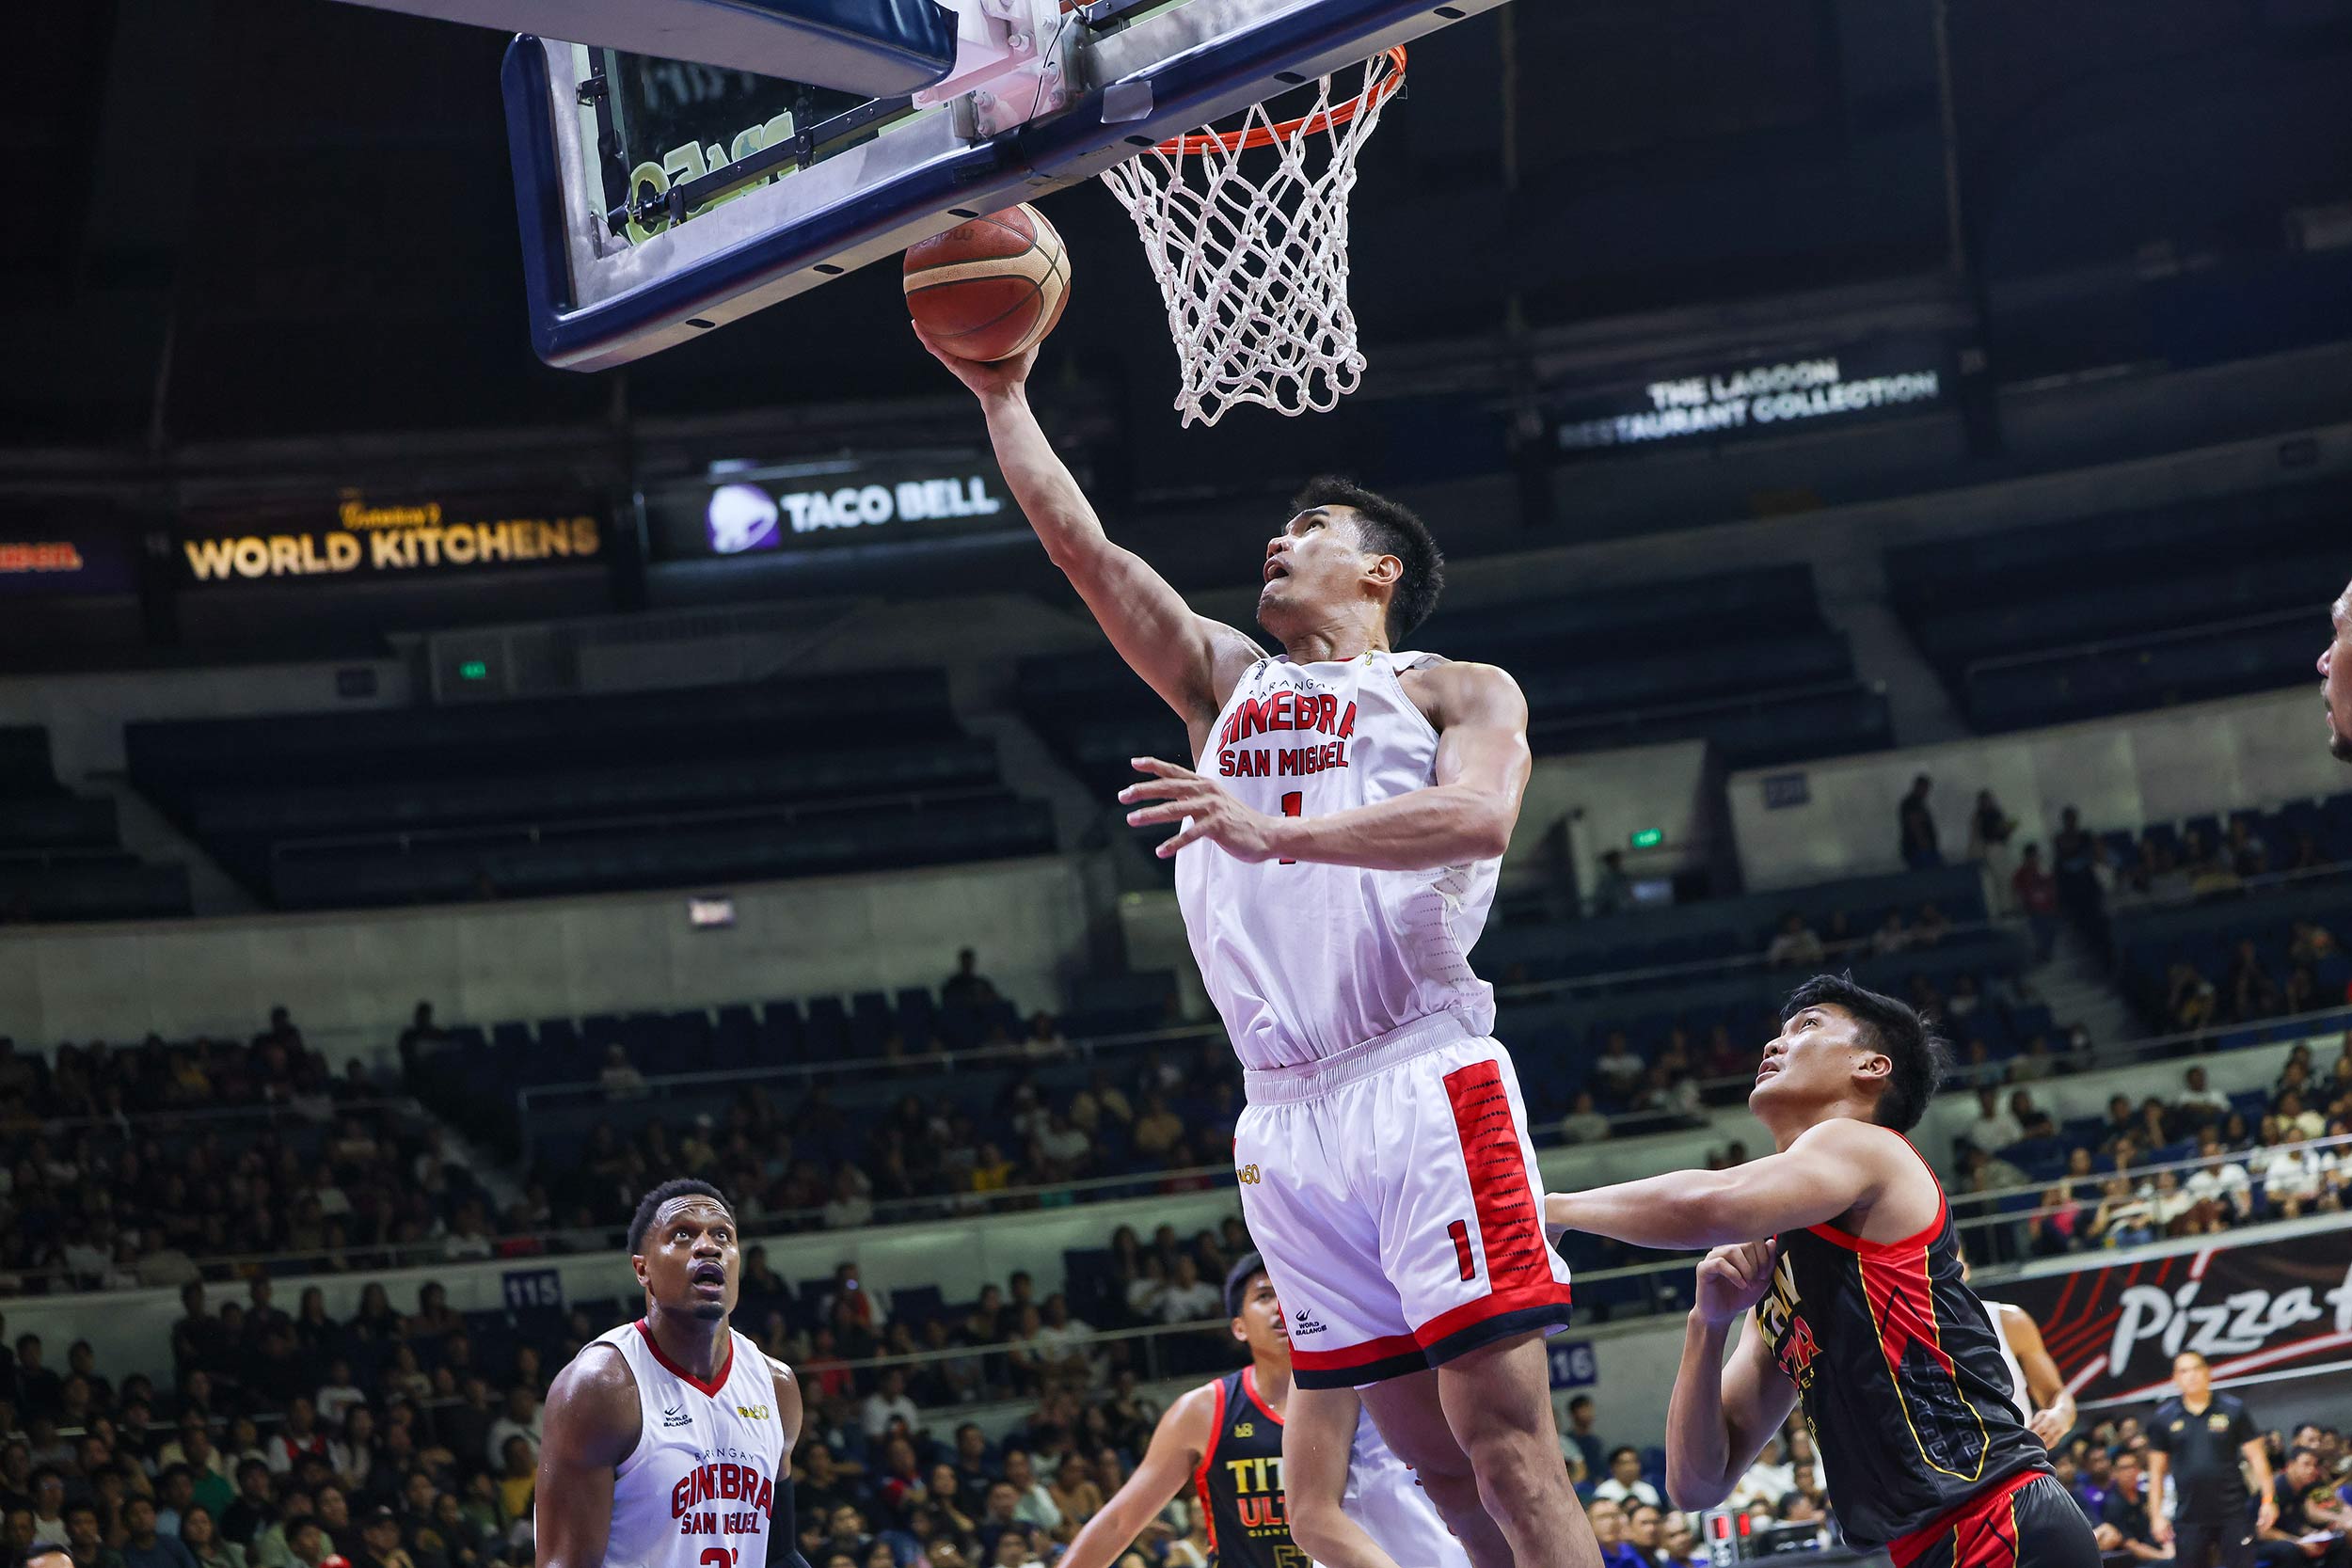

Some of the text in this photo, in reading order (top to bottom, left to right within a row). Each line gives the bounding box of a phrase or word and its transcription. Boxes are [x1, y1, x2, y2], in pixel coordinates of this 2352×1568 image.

[1645, 377, 1708, 410] THE
[1752, 371, 1939, 422] COLLECTION
[780, 476, 1001, 533] TACO BELL
[186, 517, 600, 580] WORLD KITCHENS
[1219, 741, 1348, 777] SAN MIGUEL
[1447, 1219, 1475, 1282] 1
[1295, 1324, 1327, 1336] BALANCE
[2107, 1281, 2323, 1378] Pizza
[1553, 1347, 1593, 1381] 16
[663, 1418, 693, 1428] BALANCE
[665, 1414, 689, 1422] WORLD
[1227, 1457, 1285, 1494] TIT
[680, 1512, 717, 1535] SAN
